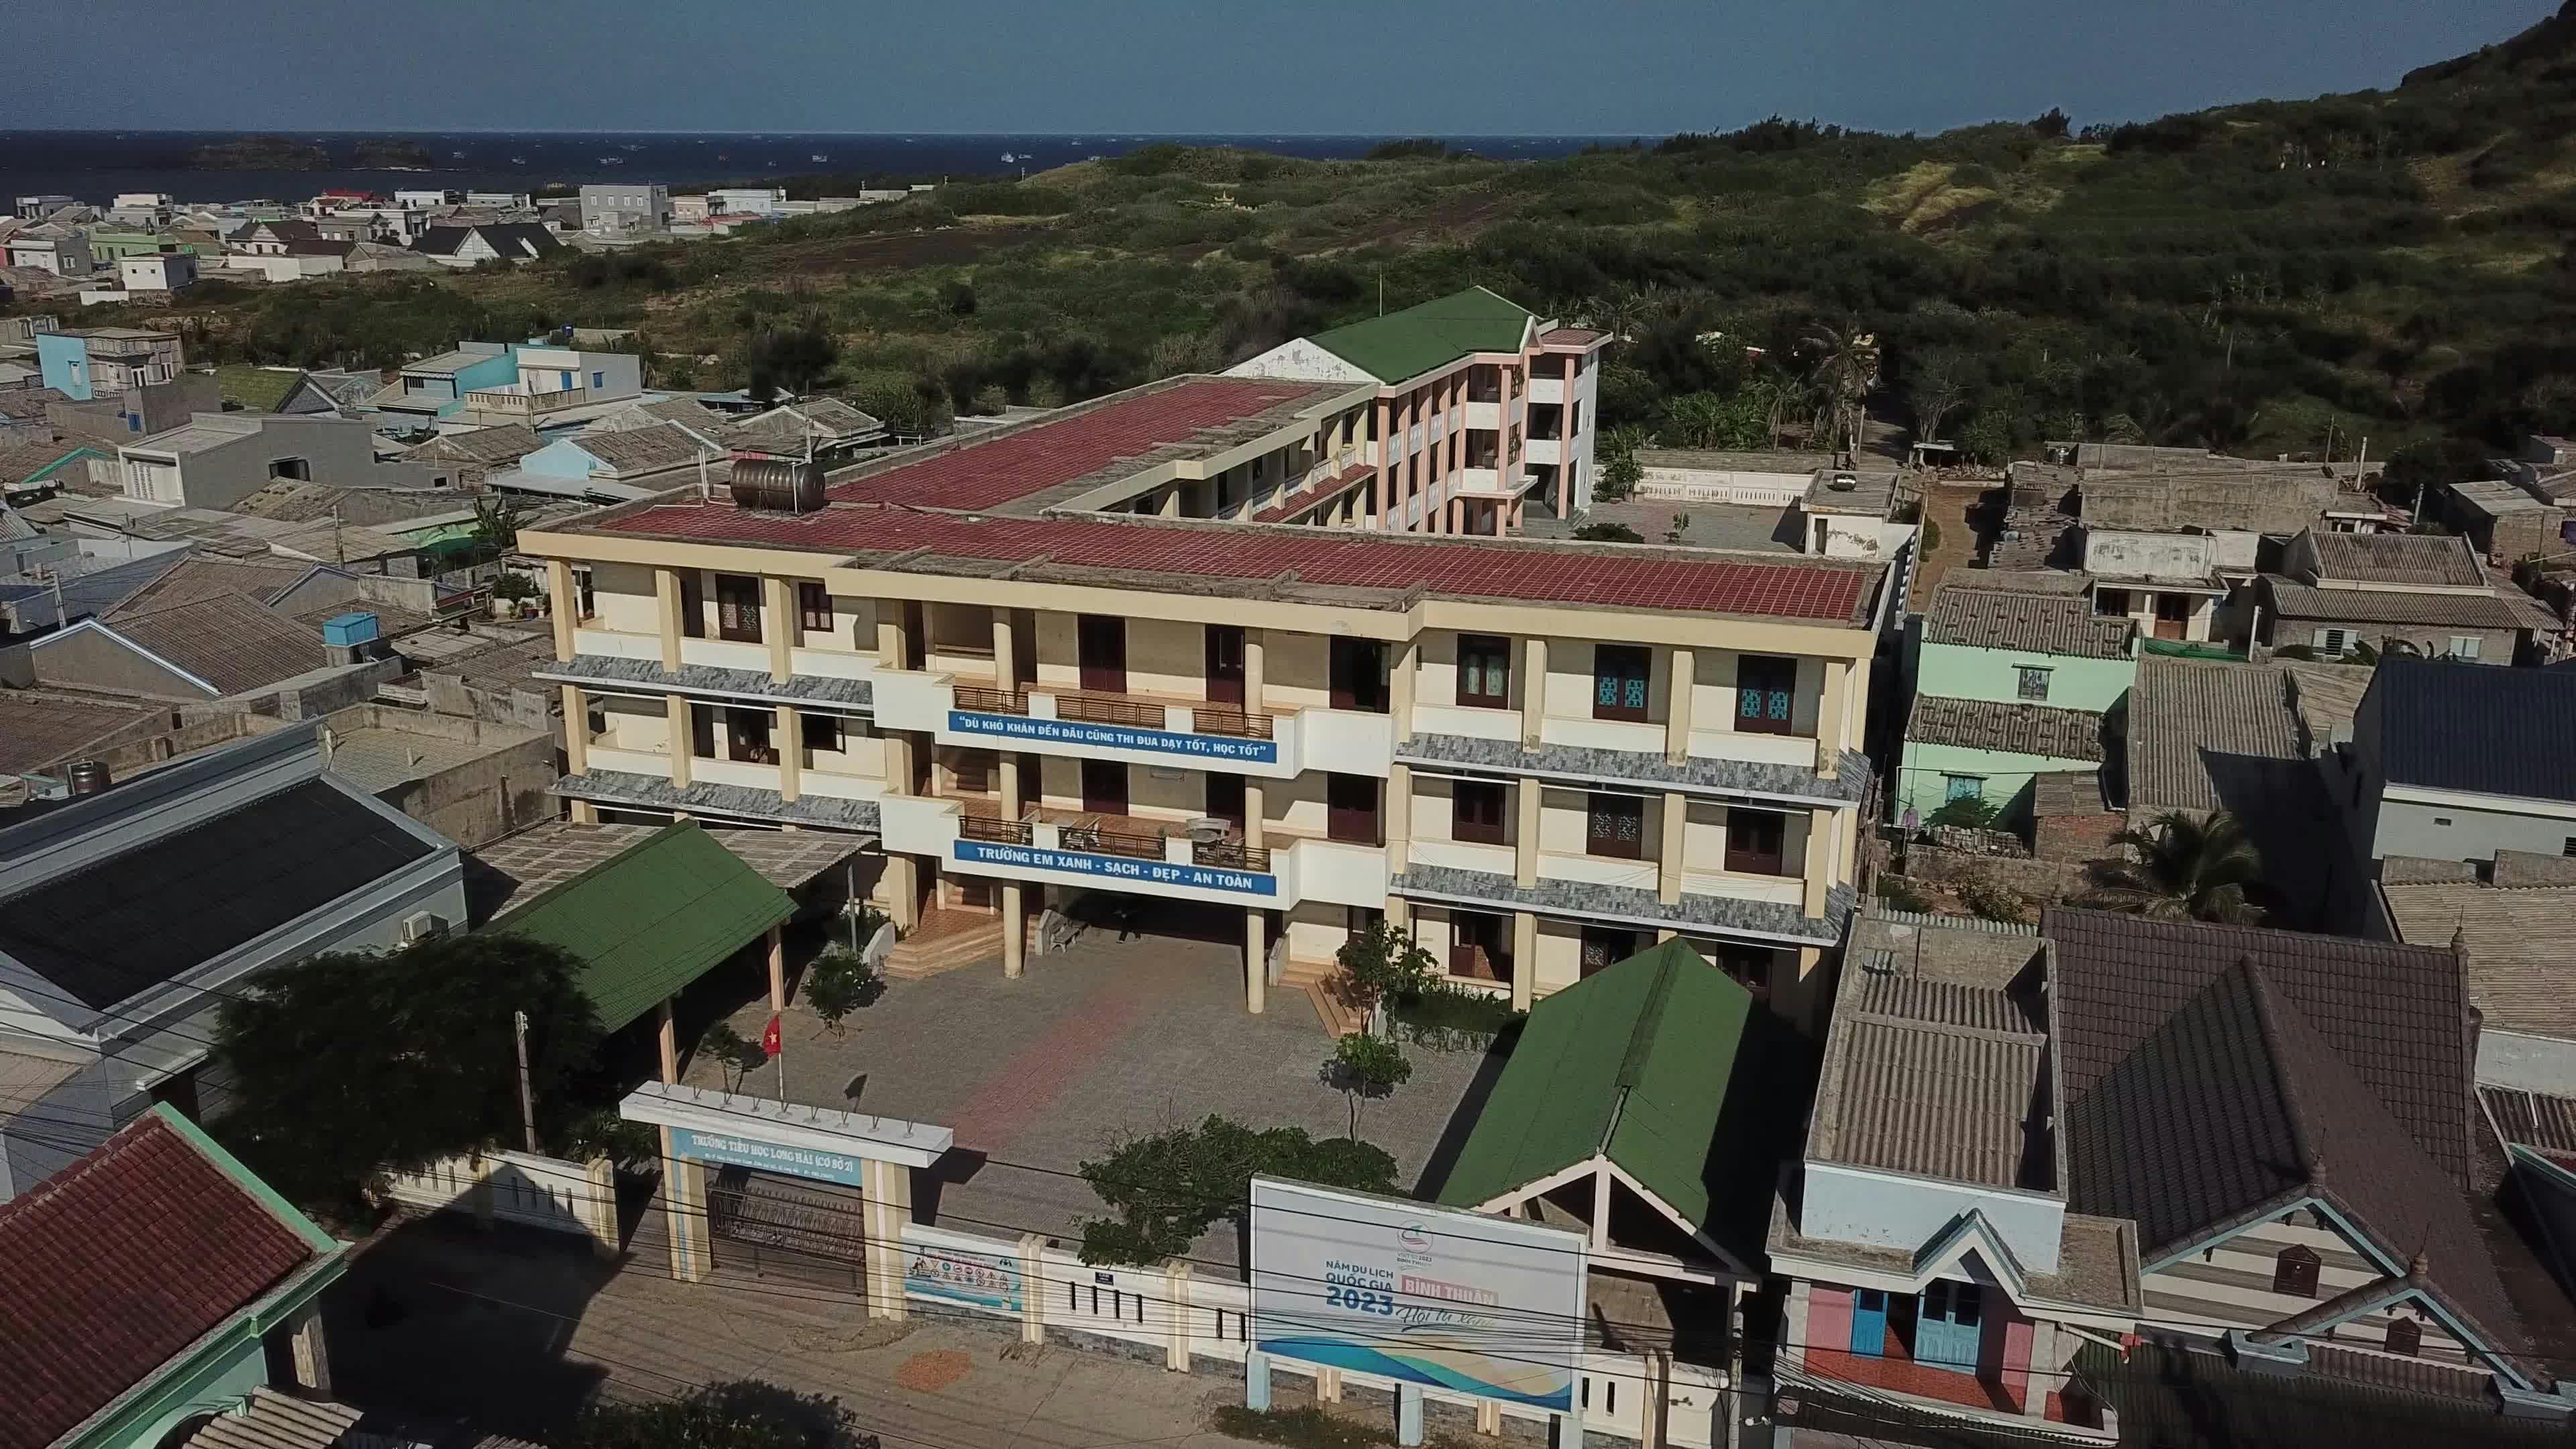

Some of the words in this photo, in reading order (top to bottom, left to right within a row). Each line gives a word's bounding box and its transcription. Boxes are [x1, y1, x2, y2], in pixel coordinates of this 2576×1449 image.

[982, 719, 1004, 731] KHÓ
[1038, 724, 1059, 737] ĐẾN
[1062, 727, 1083, 739] ĐÂU
[1086, 729, 1114, 742] CŨNG
[1116, 733, 1134, 744] THI
[1136, 736, 1158, 746] ĐUA
[1161, 739, 1183, 750] DẠY
[1185, 739, 1210, 753] TỐT,
[1213, 743, 1235, 755] HỌC
[977, 847, 1030, 863] TRƯỜNG
[1033, 853, 1053, 865] EM
[1057, 856, 1092, 870] XANH
[1105, 861, 1140, 875] SẠCH
[1152, 867, 1181, 881] ĐẸP
[1193, 872, 1212, 884] AN
[1216, 874, 1252, 889] TOÀN
[770, 1147, 795, 1161] LONG
[1326, 1260, 1350, 1271] NĂM
[1352, 1265, 1367, 1274] DU
[1326, 1272, 1366, 1288] QUỐC
[1369, 1280, 1393, 1291] GIA
[1405, 1277, 1441, 1298] BÌNH
[1326, 1286, 1393, 1316] 2023
